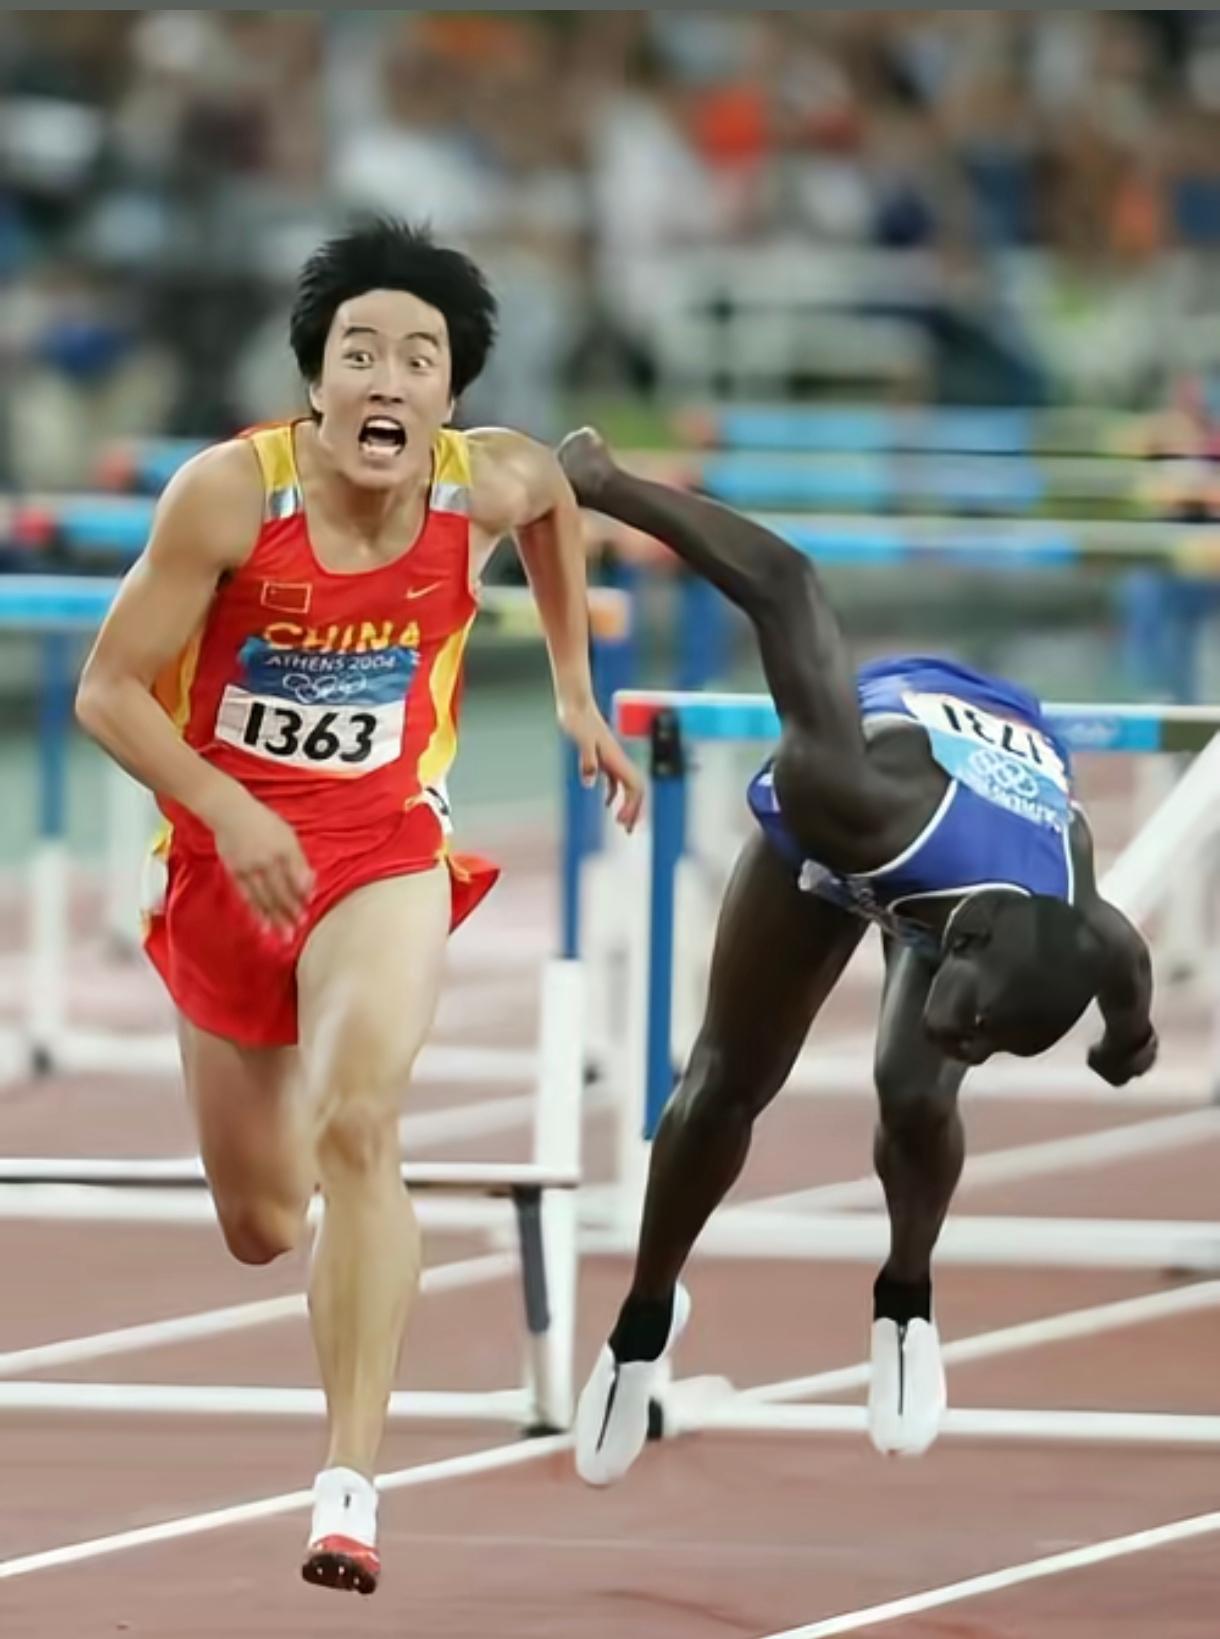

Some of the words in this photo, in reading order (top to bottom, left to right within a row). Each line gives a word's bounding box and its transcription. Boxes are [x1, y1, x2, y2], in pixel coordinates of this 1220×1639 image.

[264, 620, 420, 654] CHINA
[265, 653, 345, 673] ATHENS
[243, 702, 377, 763] 1363
